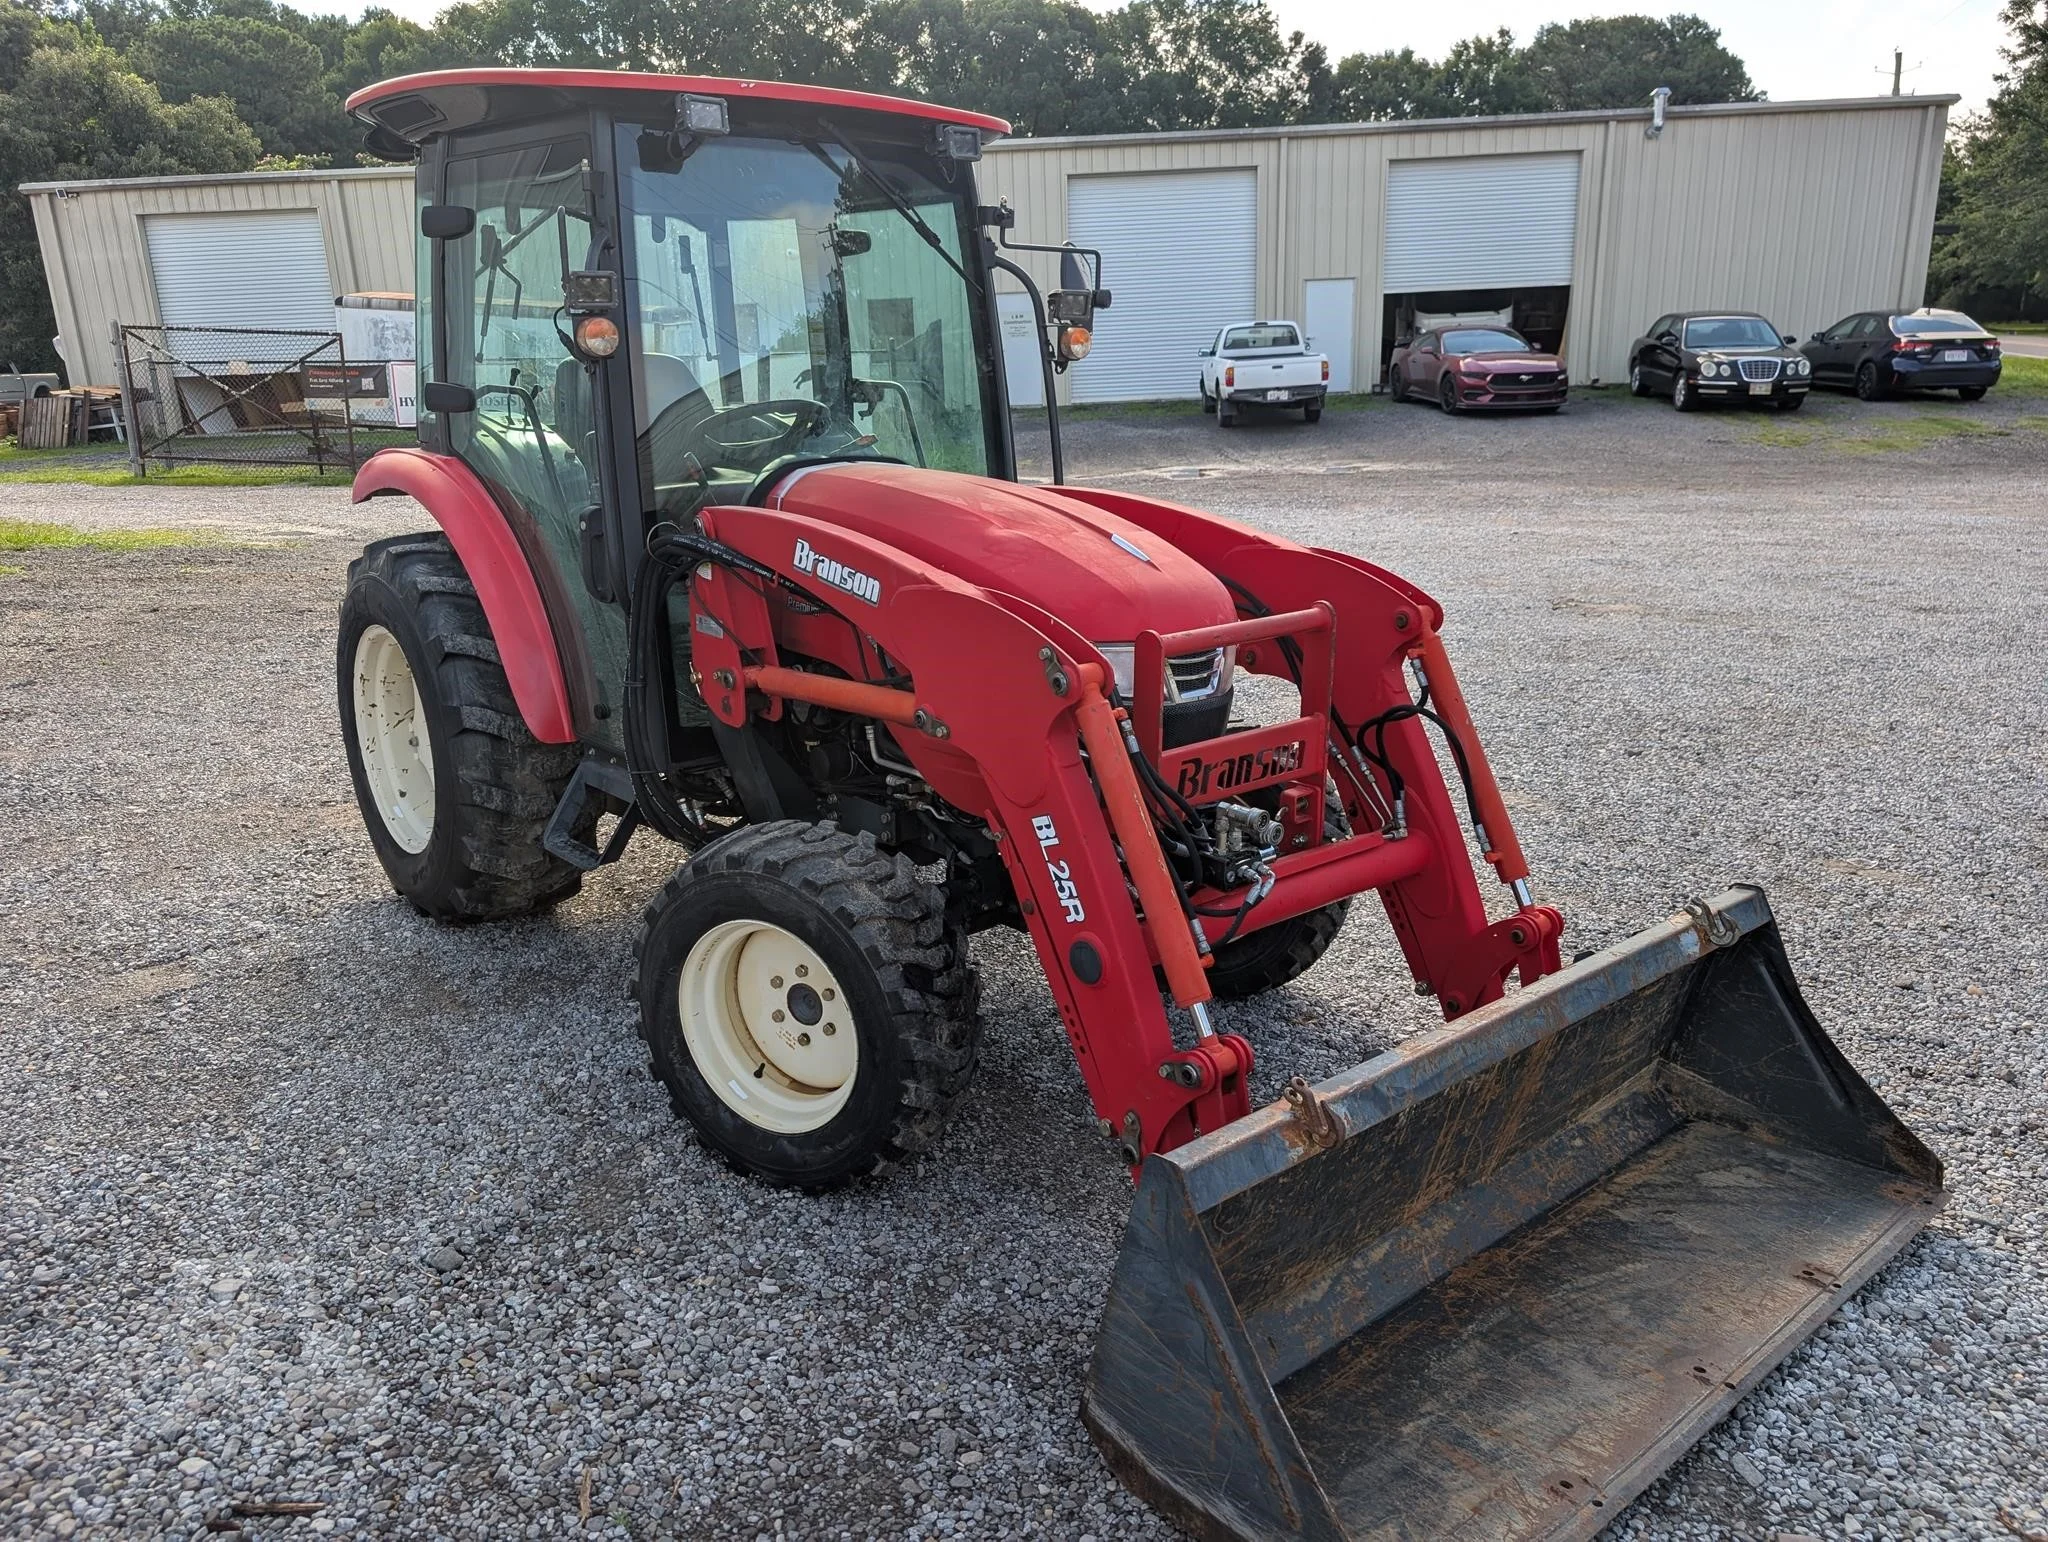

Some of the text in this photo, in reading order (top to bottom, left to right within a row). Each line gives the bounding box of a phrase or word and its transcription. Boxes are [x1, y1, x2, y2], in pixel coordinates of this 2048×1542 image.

[793, 538, 881, 607] Branson
[787, 595, 820, 616] Premi
[1177, 740, 1306, 799] Branson
